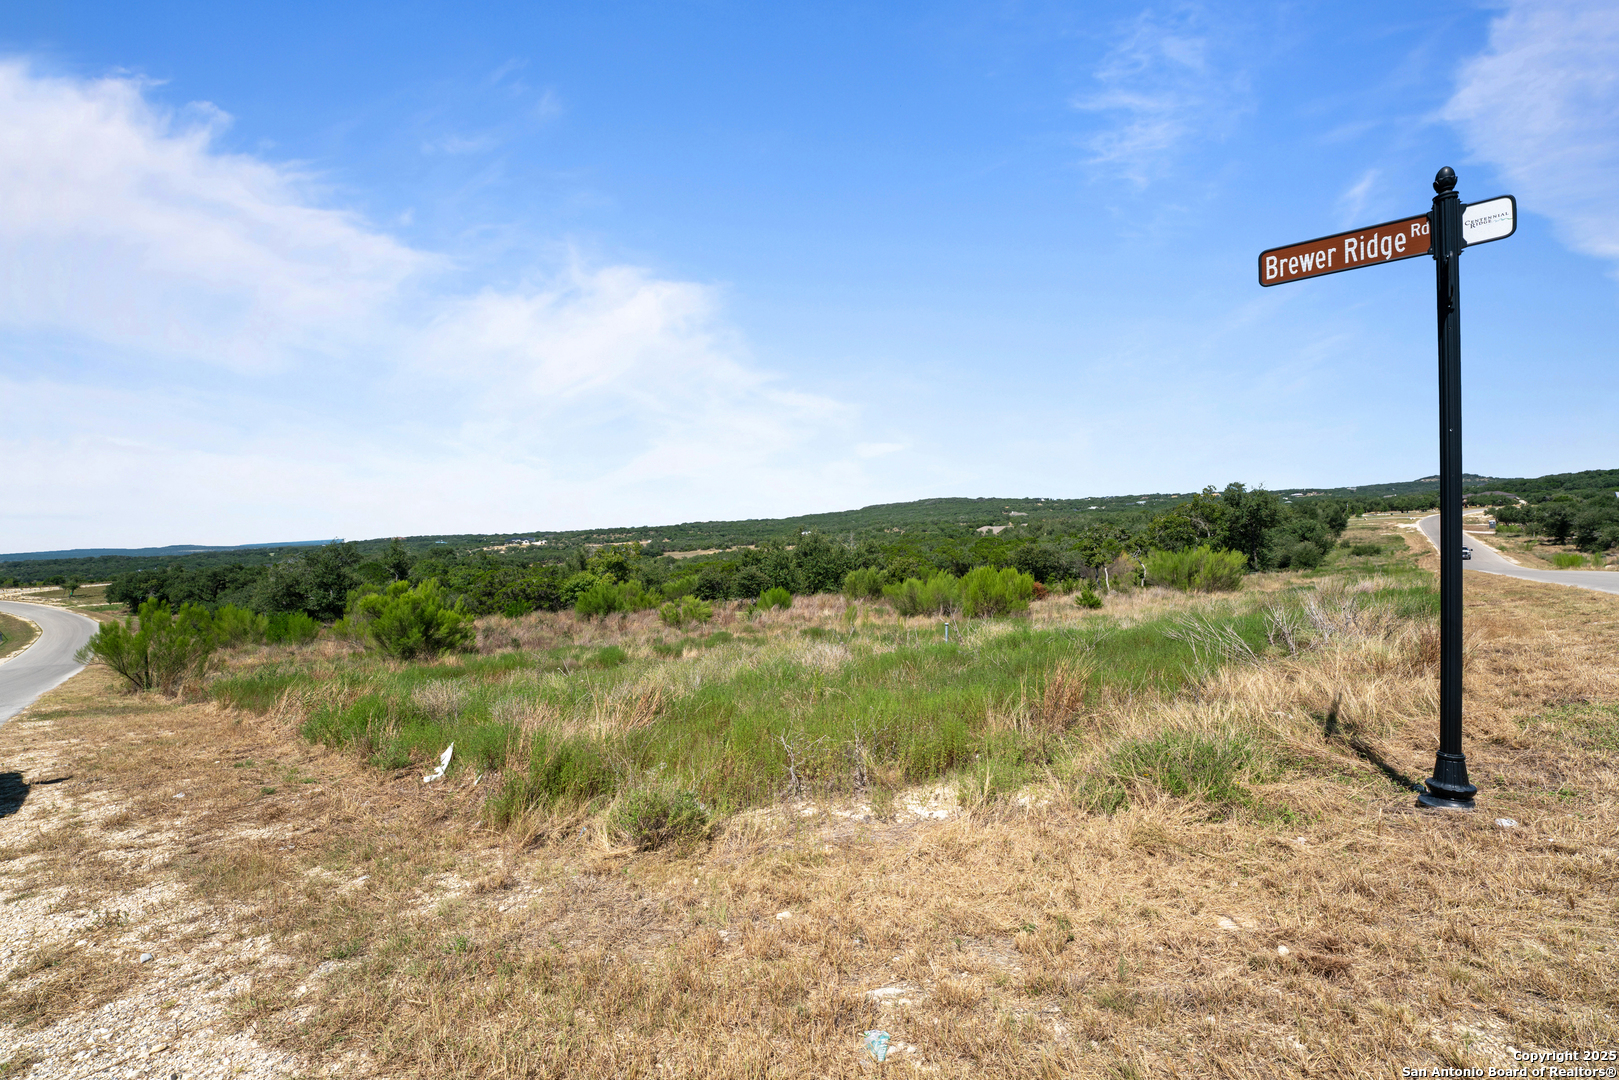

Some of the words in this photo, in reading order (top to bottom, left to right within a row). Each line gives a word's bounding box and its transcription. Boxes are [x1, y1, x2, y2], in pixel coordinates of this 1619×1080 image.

[1464, 212, 1509, 226] CENTENNIAL
[1470, 219, 1492, 229] RIDGE
[1265, 246, 1337, 280] Brewer
[1344, 232, 1407, 264] Ridge
[1410, 221, 1430, 238] Rd
